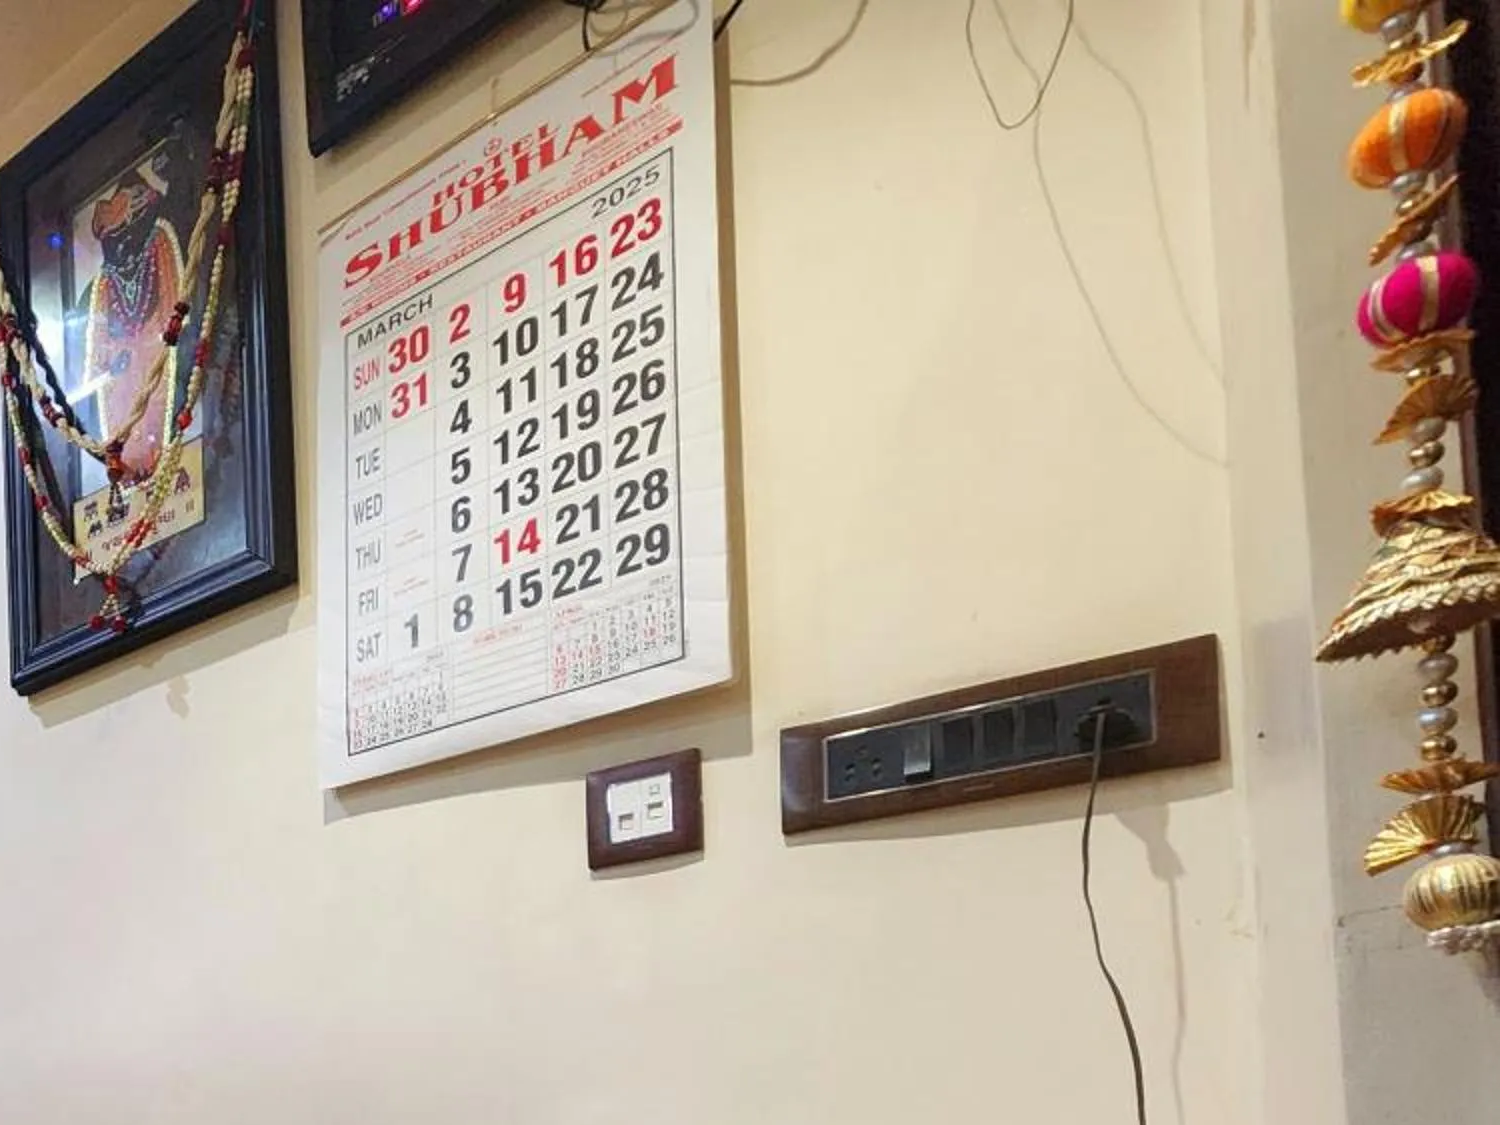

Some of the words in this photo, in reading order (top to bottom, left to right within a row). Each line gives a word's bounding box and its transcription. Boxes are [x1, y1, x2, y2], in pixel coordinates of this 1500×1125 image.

[344, 54, 678, 289] SHUBHAM
[432, 123, 561, 209] HOTEL
[591, 164, 661, 219] 2025
[353, 357, 380, 392] SUN
[388, 325, 430, 374] 30
[449, 303, 471, 345] 2
[503, 272, 527, 314] 9
[549, 233, 599, 289] 16
[610, 197, 663, 261] 23
[353, 402, 382, 436] MON
[391, 371, 428, 419] 31
[449, 351, 472, 390] 3
[492, 315, 539, 367] 10
[550, 283, 599, 338] 17
[610, 250, 665, 312] 24
[357, 293, 433, 349] MARCH
[354, 494, 383, 525] WED
[450, 446, 472, 485] 5
[492, 416, 541, 466] 12
[550, 388, 601, 441] 19
[611, 358, 667, 417] 26
[356, 448, 381, 479] TUE
[449, 398, 473, 435] 4
[495, 365, 537, 415] 11
[550, 336, 600, 390] 18
[611, 303, 666, 365] 25
[355, 540, 381, 570] THU
[451, 495, 472, 534] 6
[492, 466, 541, 516] 13
[550, 440, 603, 495] 20
[612, 411, 667, 470] 27
[358, 587, 380, 616] FRI
[451, 543, 473, 583] 7
[493, 517, 542, 566] 14
[555, 493, 601, 546] 21
[613, 467, 670, 525] 28
[356, 632, 382, 663] SAT
[404, 613, 419, 649] 1
[453, 594, 474, 633] 8
[495, 567, 544, 616] 15
[550, 547, 603, 601] 22
[615, 522, 671, 578] 29
